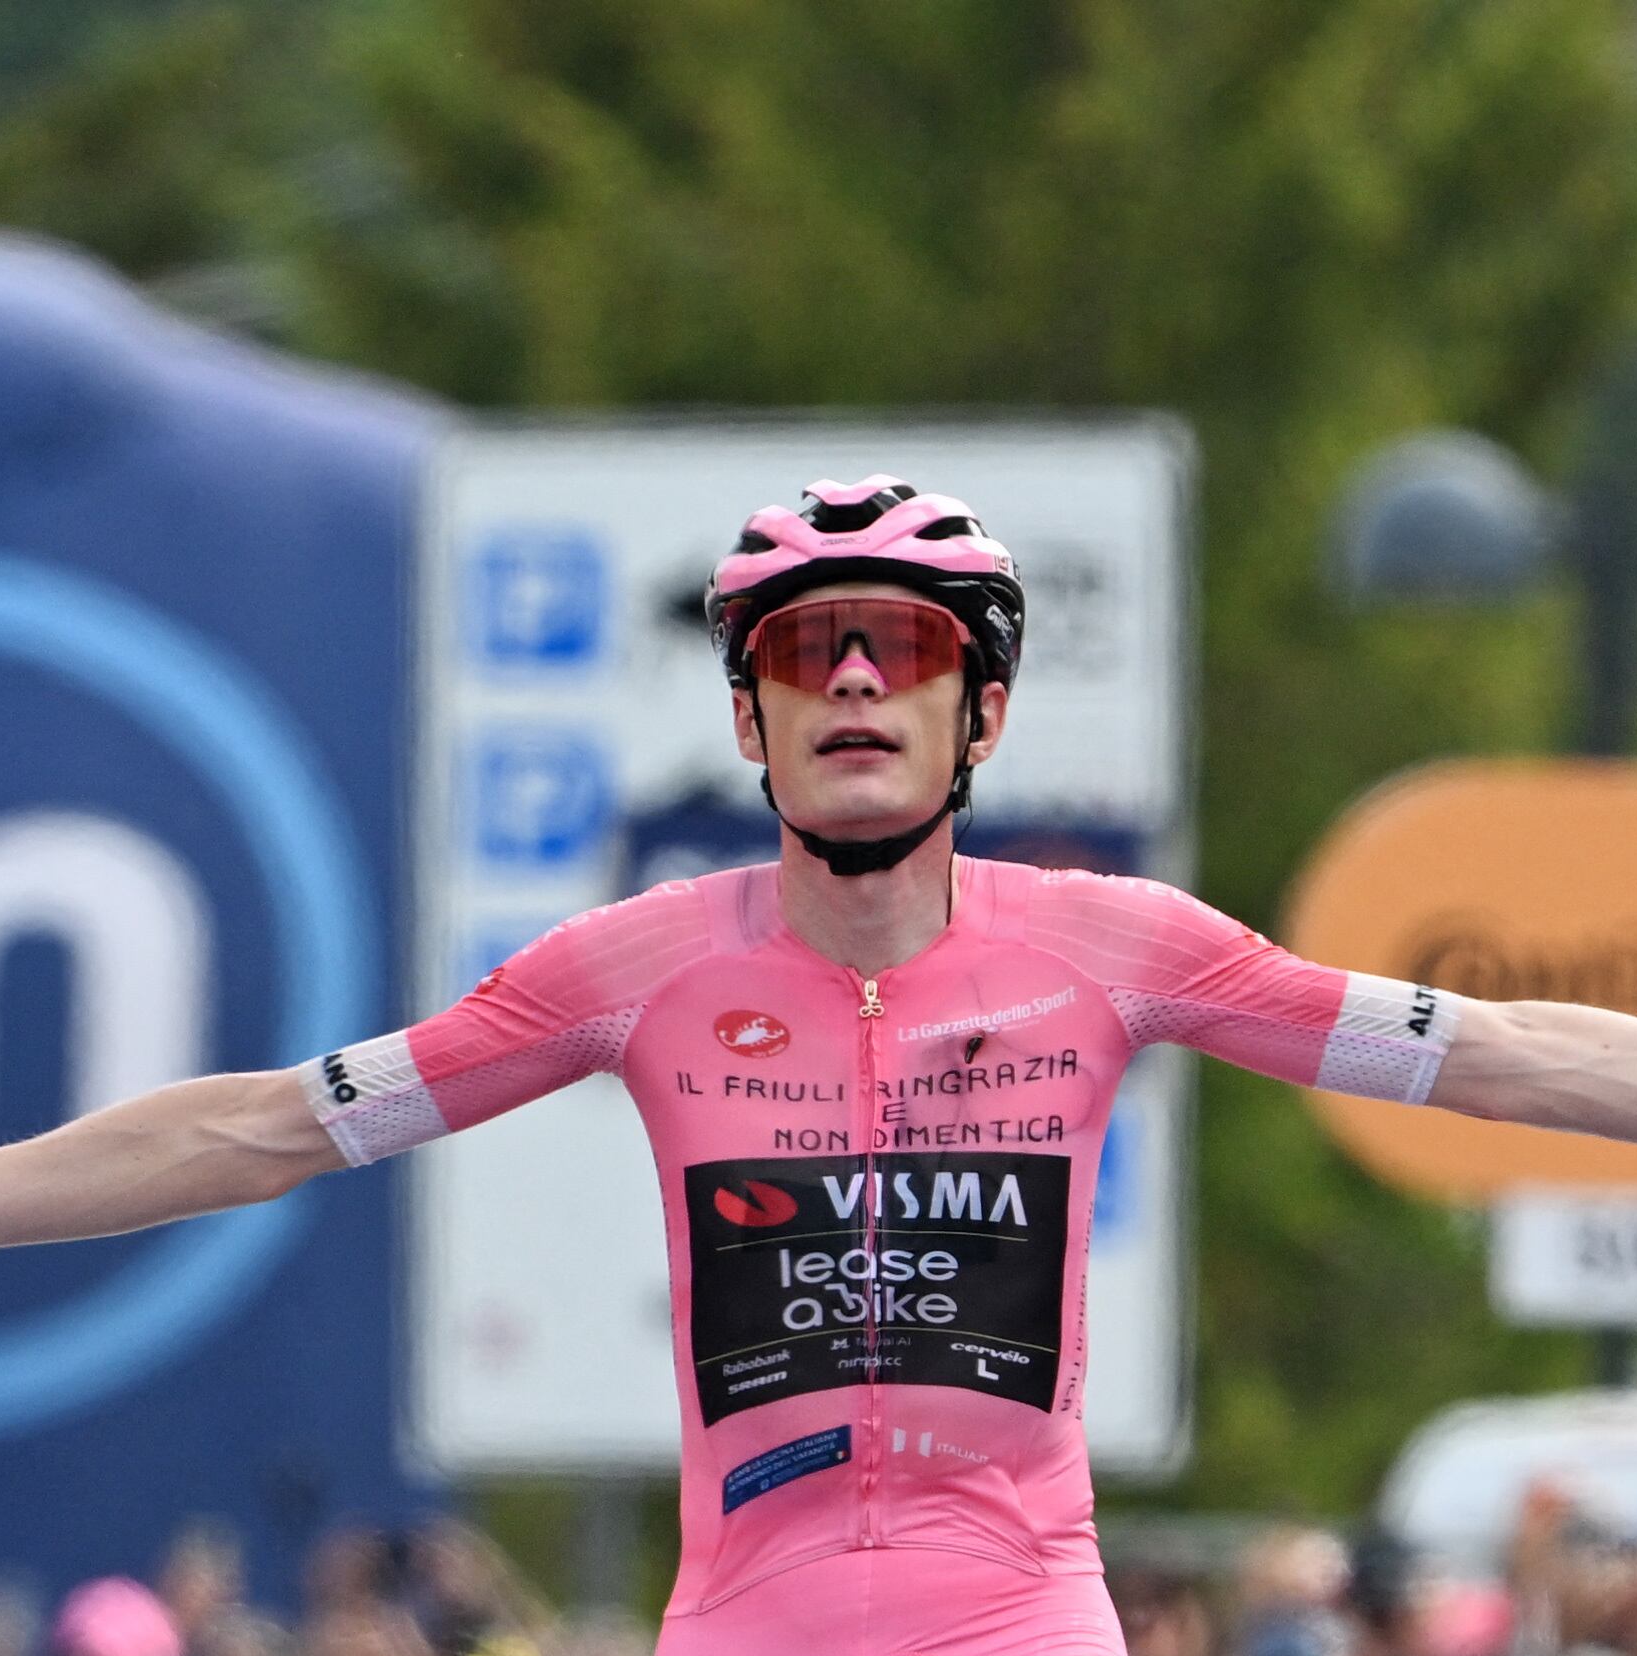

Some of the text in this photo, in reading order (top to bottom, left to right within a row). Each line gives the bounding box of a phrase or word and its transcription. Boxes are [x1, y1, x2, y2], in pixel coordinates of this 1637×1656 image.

[920, 1014, 990, 1040] Gazzetta
[992, 1001, 1032, 1025] dello
[1032, 985, 1077, 1017] Sport
[1408, 986, 1437, 1038] ALT
[677, 1049, 1077, 1102] IL FRIULI RINGRAZIA
[774, 1115, 1064, 1152] NON DIMENTICA
[883, 1102, 907, 1123] E
[822, 1171, 1028, 1227] VISMA
[780, 1248, 959, 1287] lease
